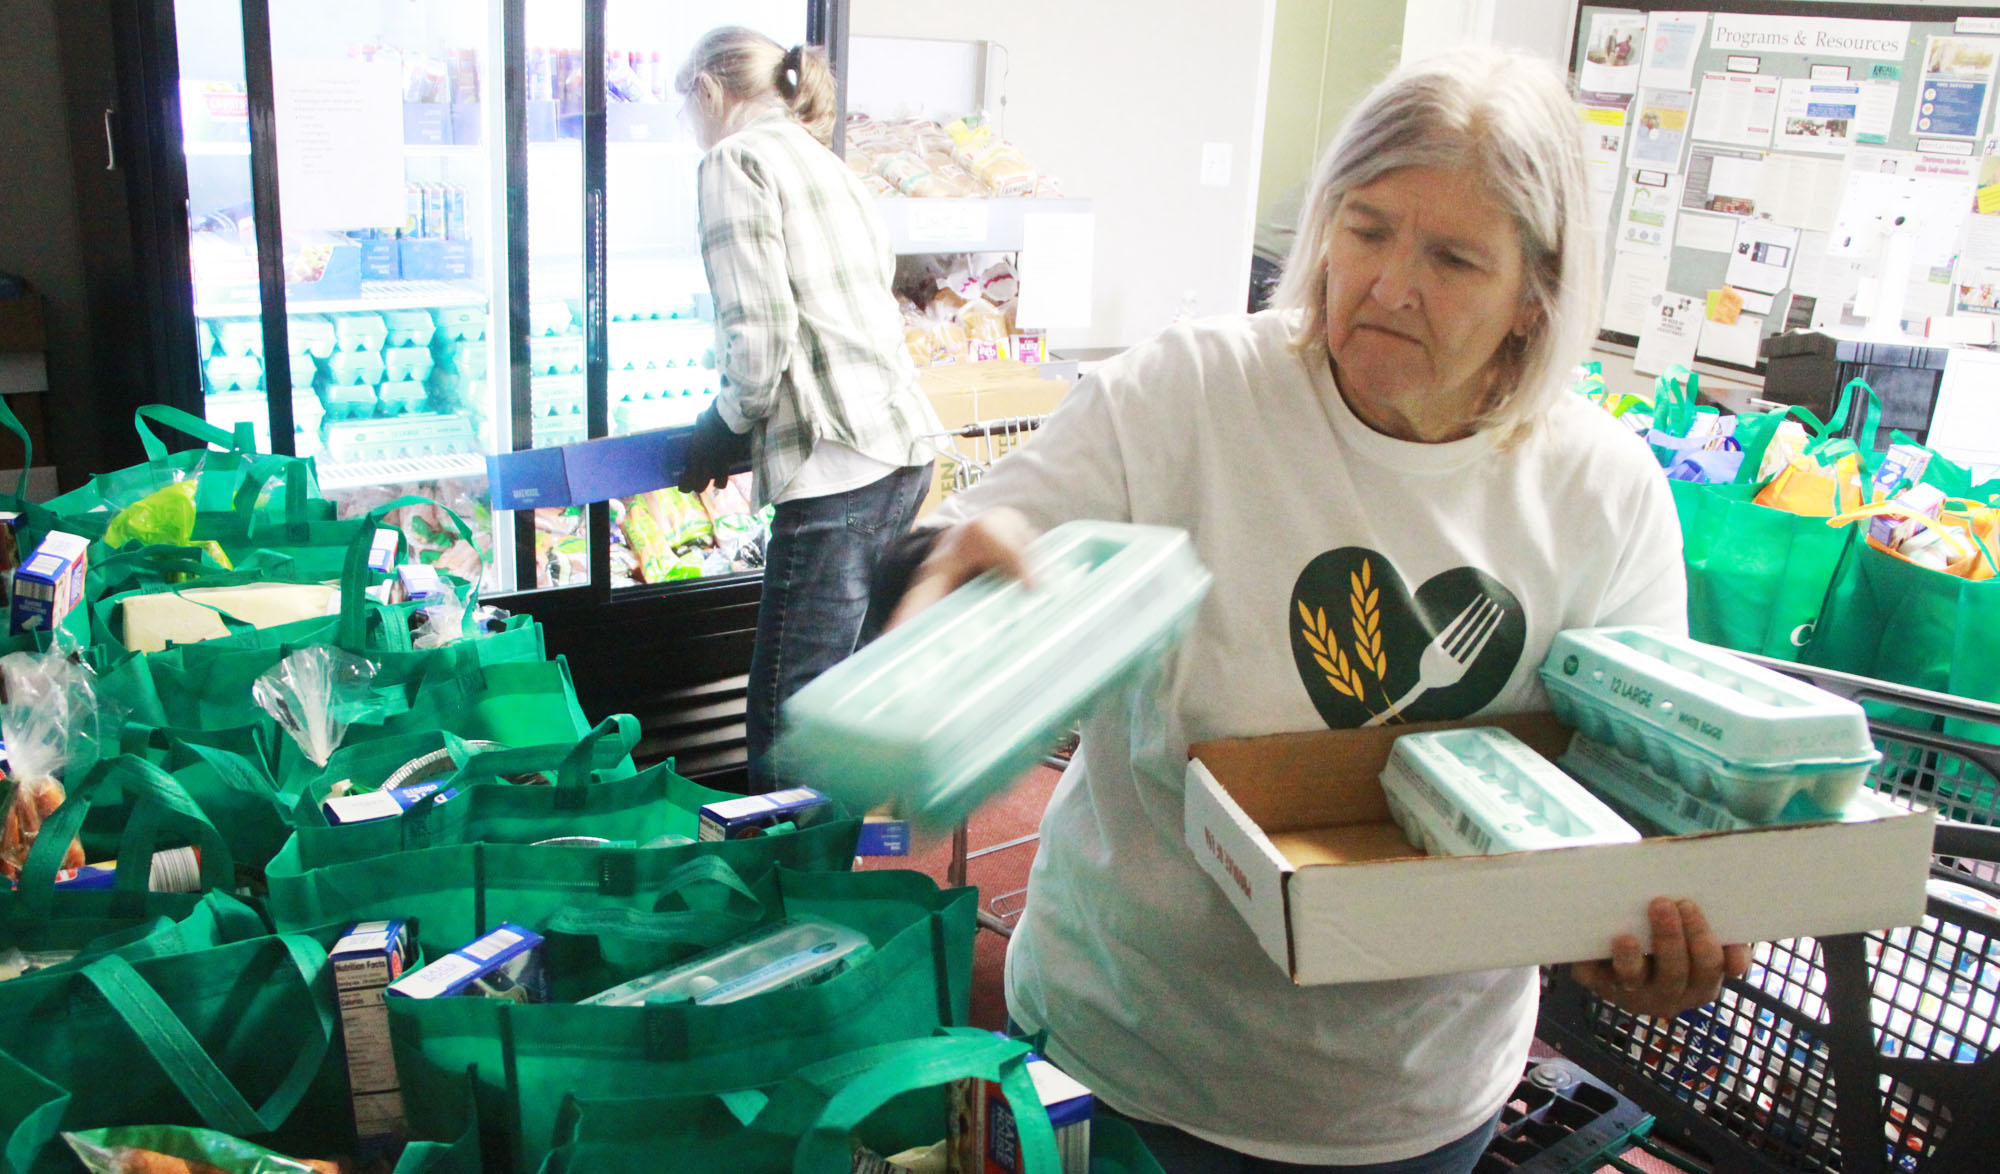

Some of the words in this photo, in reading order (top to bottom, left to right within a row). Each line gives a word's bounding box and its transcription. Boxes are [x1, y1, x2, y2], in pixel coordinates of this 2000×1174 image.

[1715, 26, 1789, 48] Programs
[1794, 30, 1807, 46] &
[1816, 31, 1899, 52] Resources
[1611, 676, 1621, 694] 12
[1621, 681, 1654, 708] LARGE
[335, 962, 365, 973] Nutrition
[366, 960, 386, 969] Facts
